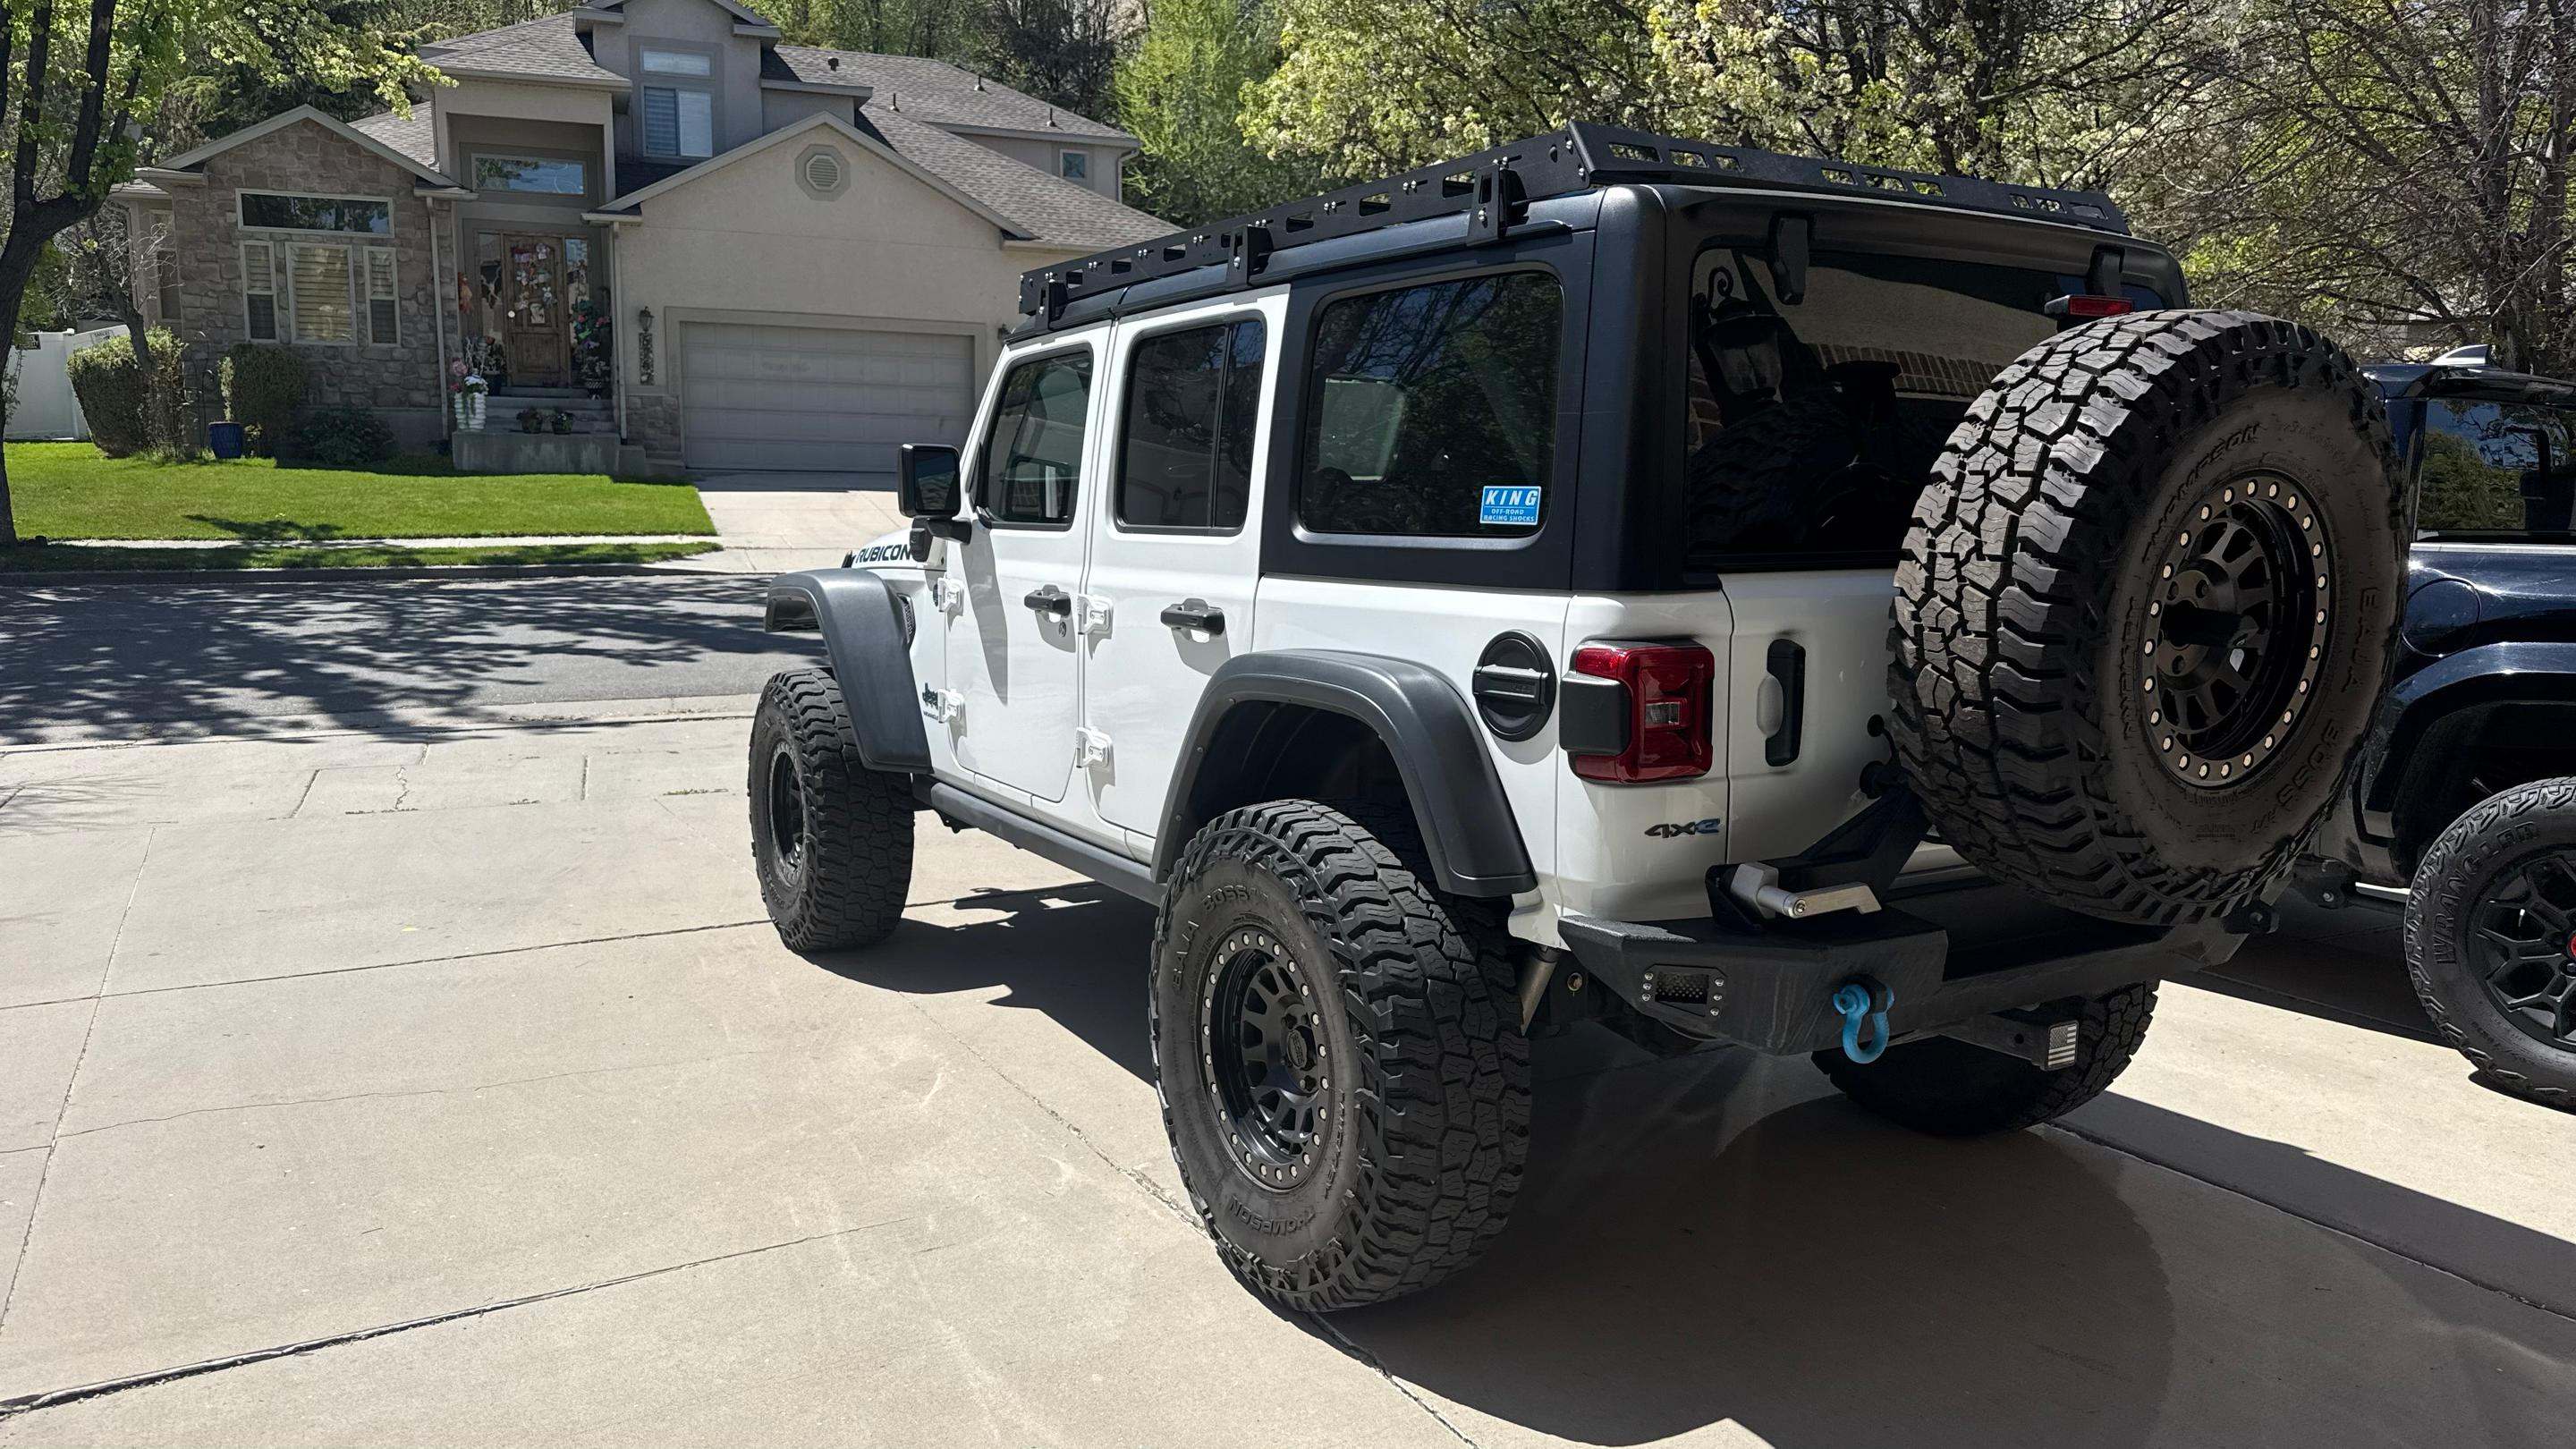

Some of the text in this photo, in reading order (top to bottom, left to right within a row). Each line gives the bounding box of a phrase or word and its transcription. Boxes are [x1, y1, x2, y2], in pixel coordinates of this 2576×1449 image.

[1485, 489, 1538, 506] KING
[856, 544, 912, 564] RUBICON
[2433, 821, 2540, 964] WRANGLER
